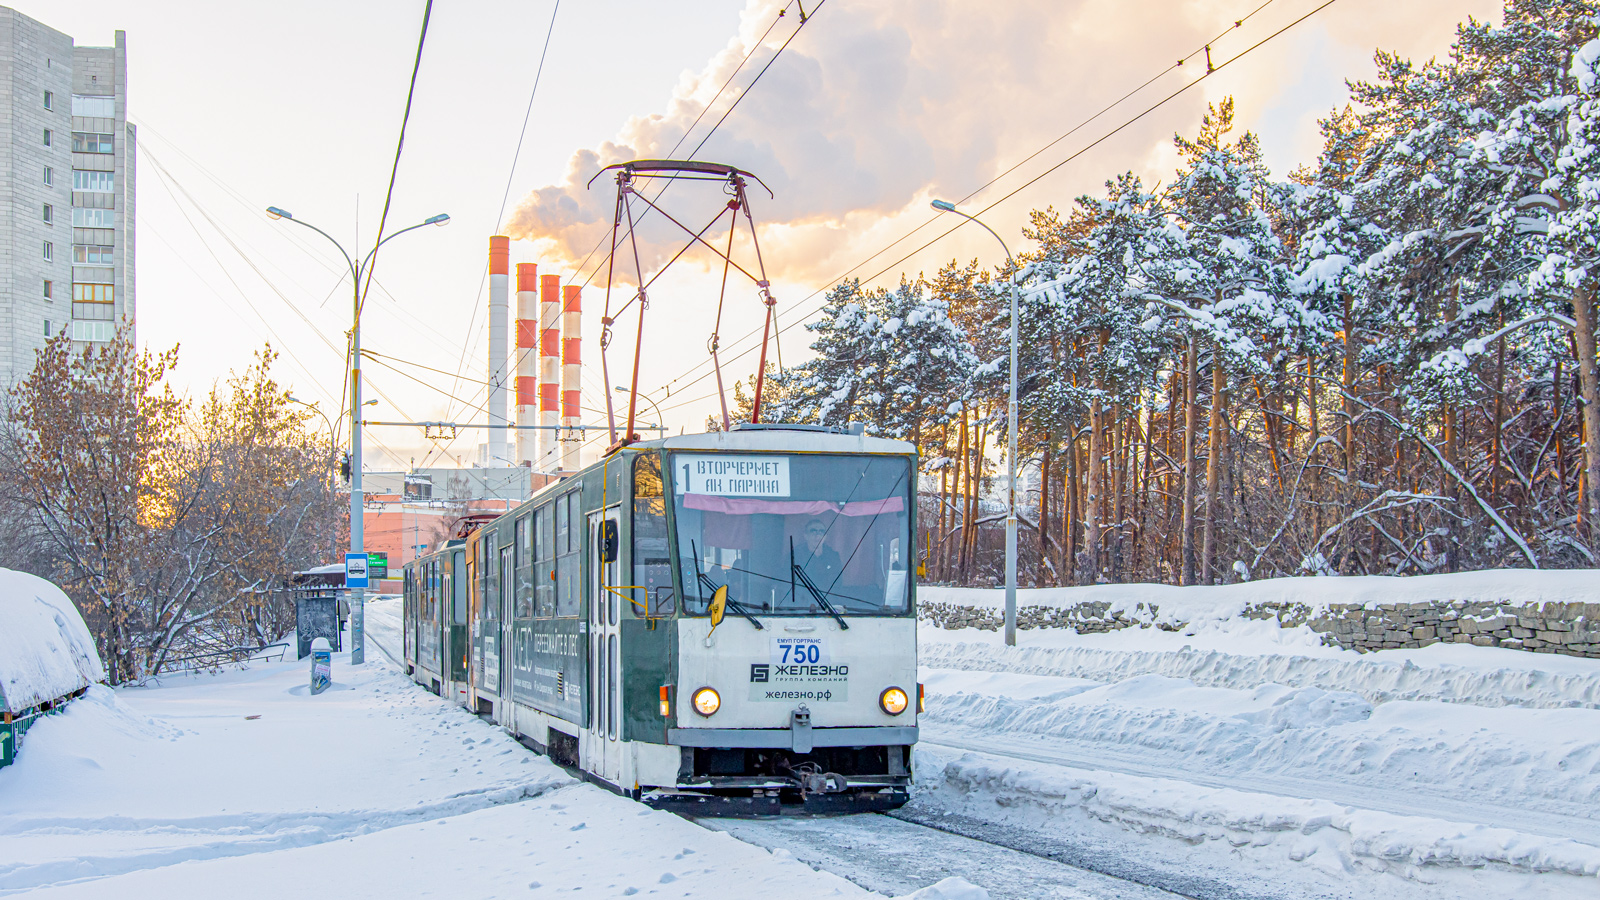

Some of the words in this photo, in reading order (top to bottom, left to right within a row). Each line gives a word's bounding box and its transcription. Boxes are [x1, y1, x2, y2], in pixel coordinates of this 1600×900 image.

[697, 460, 780, 476] ВТОРЧЕРМЕТ
[682, 463, 690, 492] 1
[729, 479, 779, 494] ПАРИНА
[779, 644, 820, 664] 750
[775, 665, 849, 676] ЖЕЛЕЗНО
[765, 689, 832, 701] железно.рф
